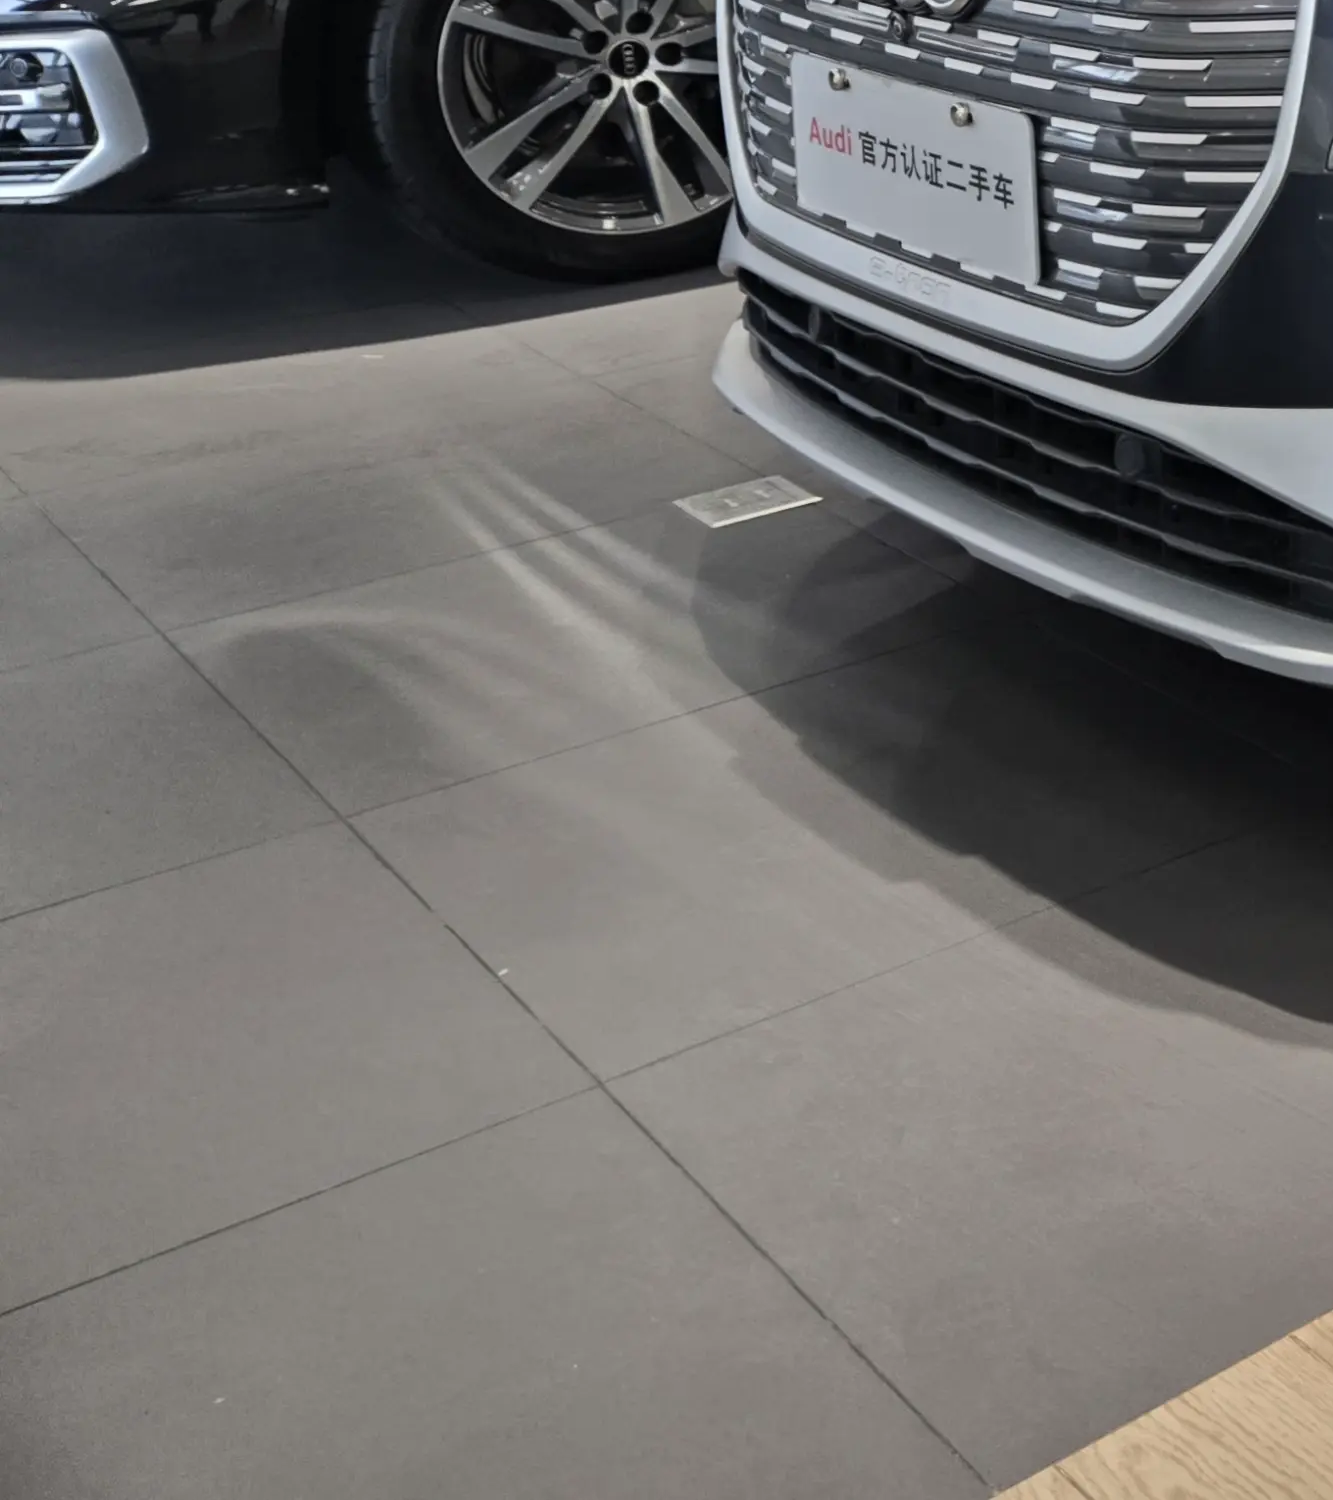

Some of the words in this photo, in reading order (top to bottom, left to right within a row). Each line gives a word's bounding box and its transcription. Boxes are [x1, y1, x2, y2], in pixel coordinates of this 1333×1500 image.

[809, 116, 852, 156] Audi
[858, 131, 1015, 209] 官方认证二手车
